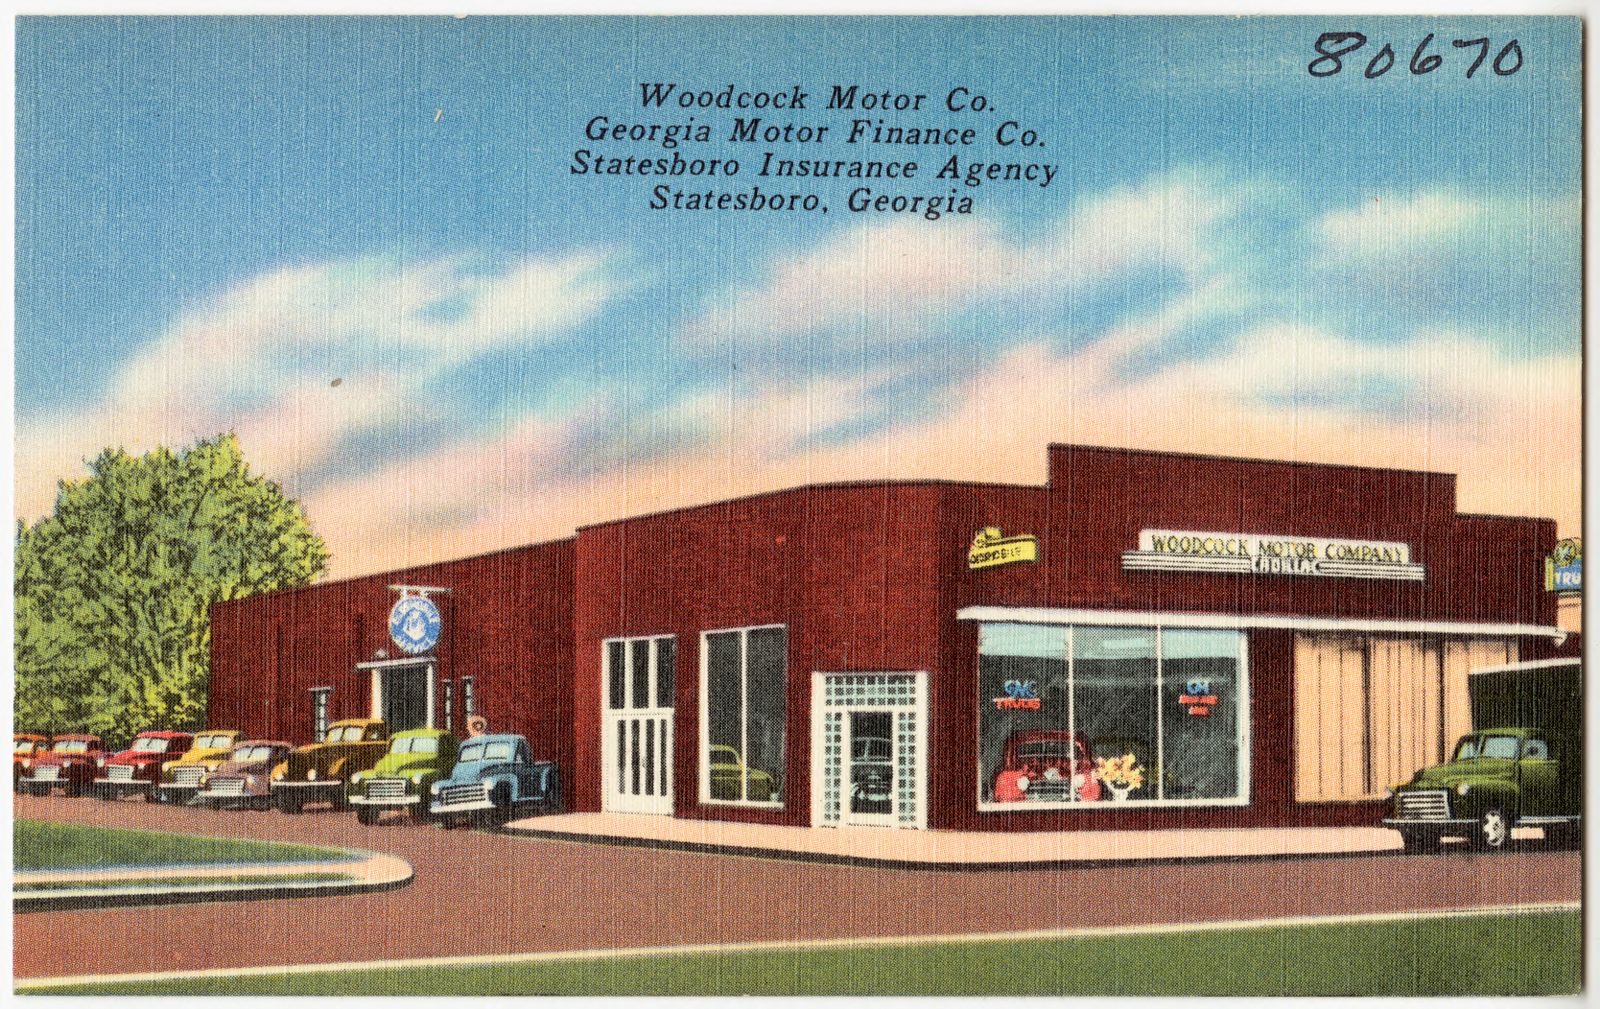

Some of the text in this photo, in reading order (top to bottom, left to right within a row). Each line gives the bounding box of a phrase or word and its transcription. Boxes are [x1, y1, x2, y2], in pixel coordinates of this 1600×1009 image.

[1308, 31, 1523, 79] 80670
[1152, 534, 1403, 562] WOODCOCK MOTOR COMPANY
